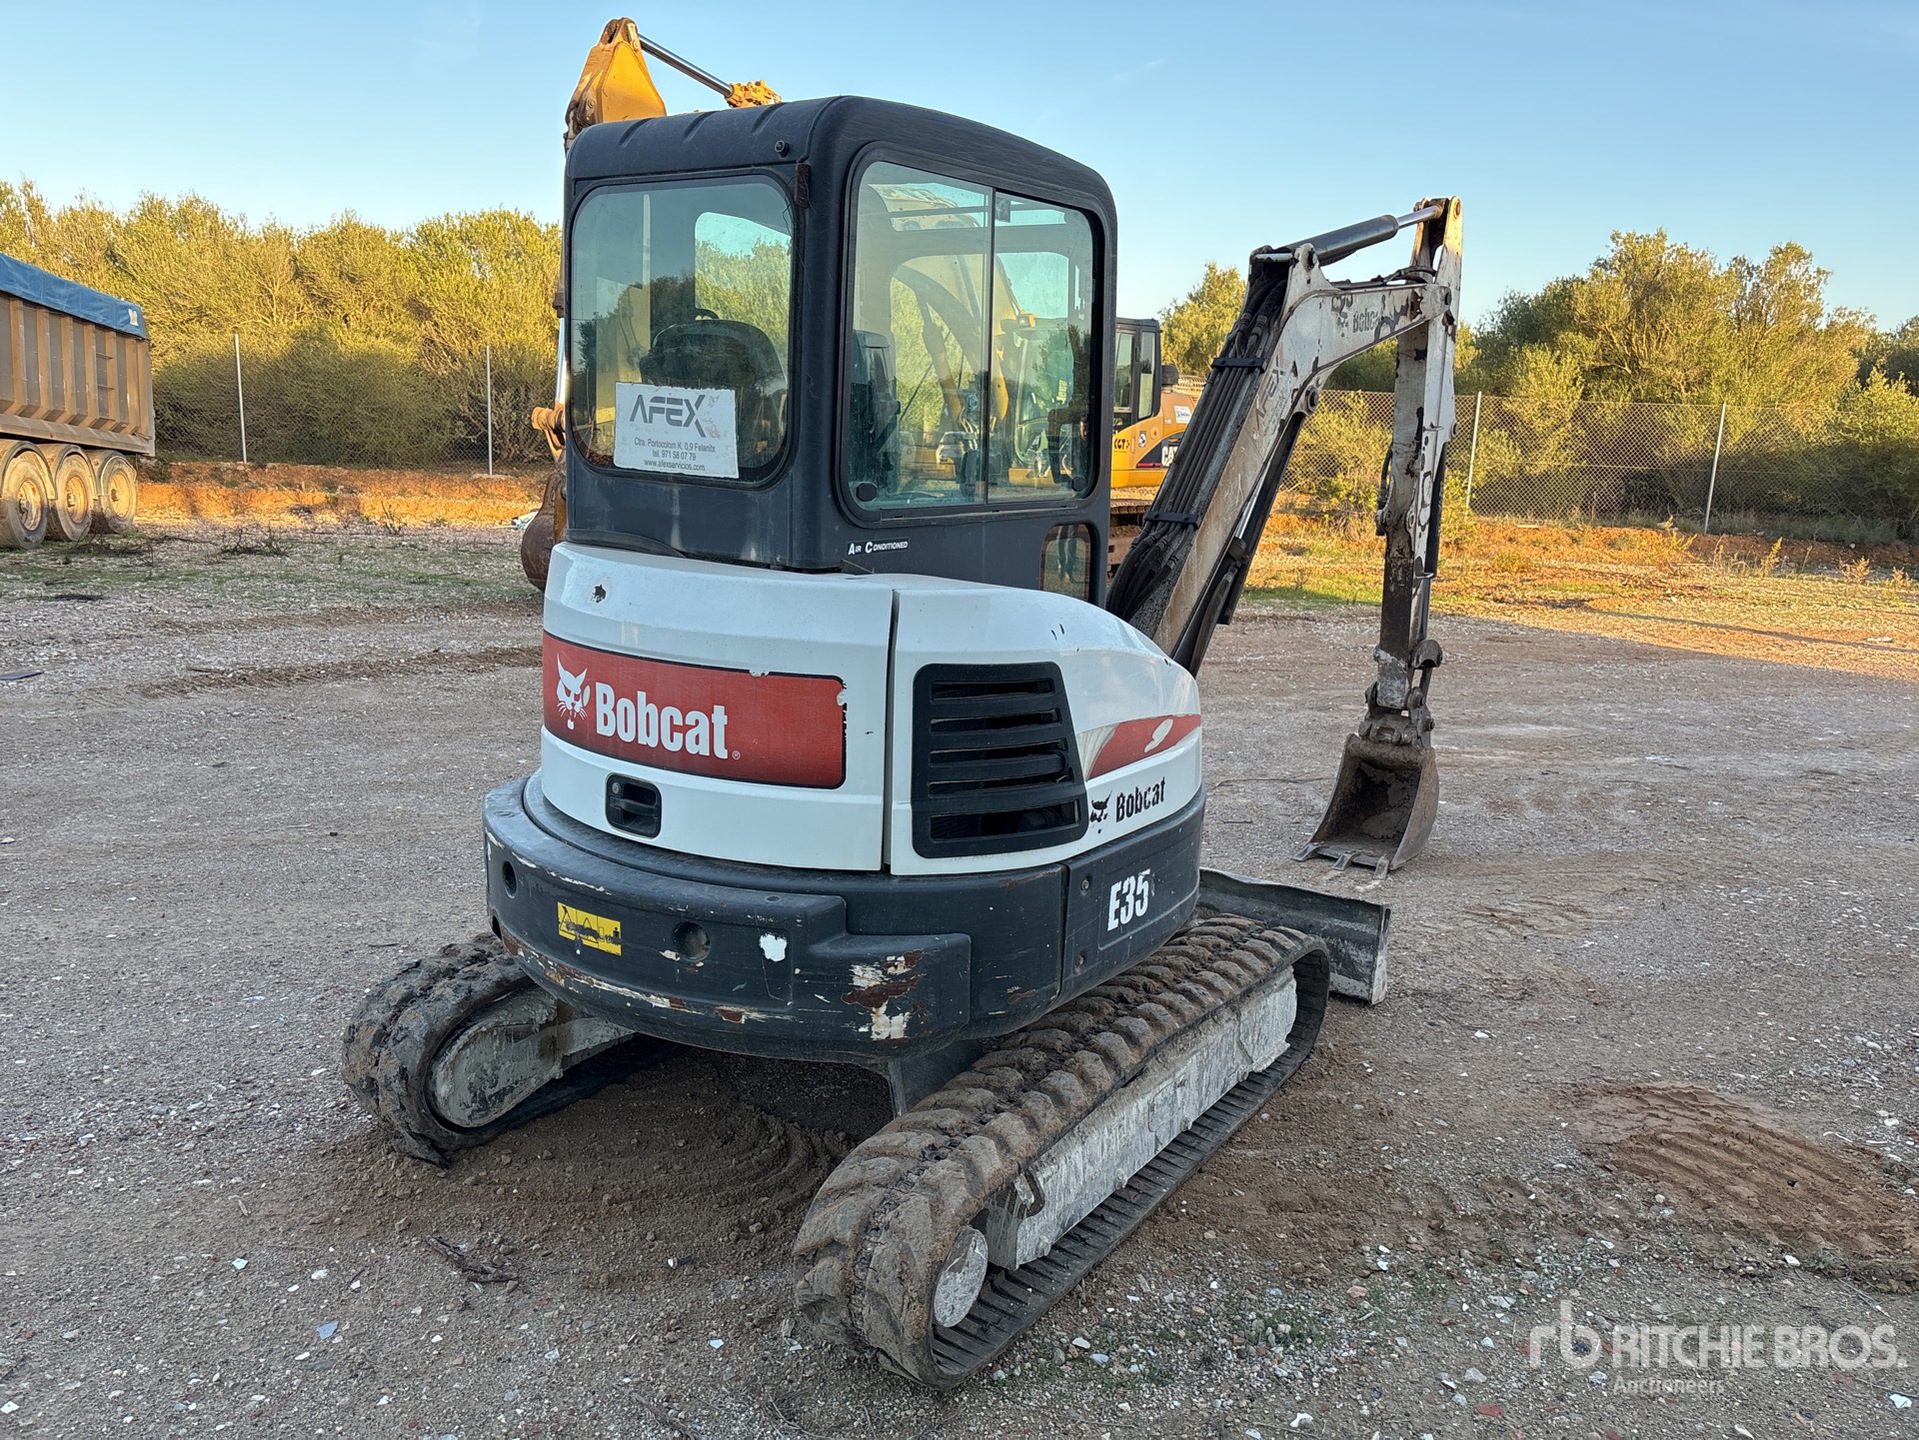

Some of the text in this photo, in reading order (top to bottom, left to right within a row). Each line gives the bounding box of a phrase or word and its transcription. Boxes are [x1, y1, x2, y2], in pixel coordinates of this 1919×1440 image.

[629, 394, 706, 437] AFEX
[634, 437, 646, 446] Ctra.
[648, 438, 676, 449] Portocolom
[661, 450, 671, 458] 971
[681, 451, 687, 460] 07
[644, 459, 705, 471] www.afexservicios.com
[595, 682, 728, 759] Bobcat
[1116, 777, 1166, 822] Bobcat
[1107, 868, 1151, 931] E35
